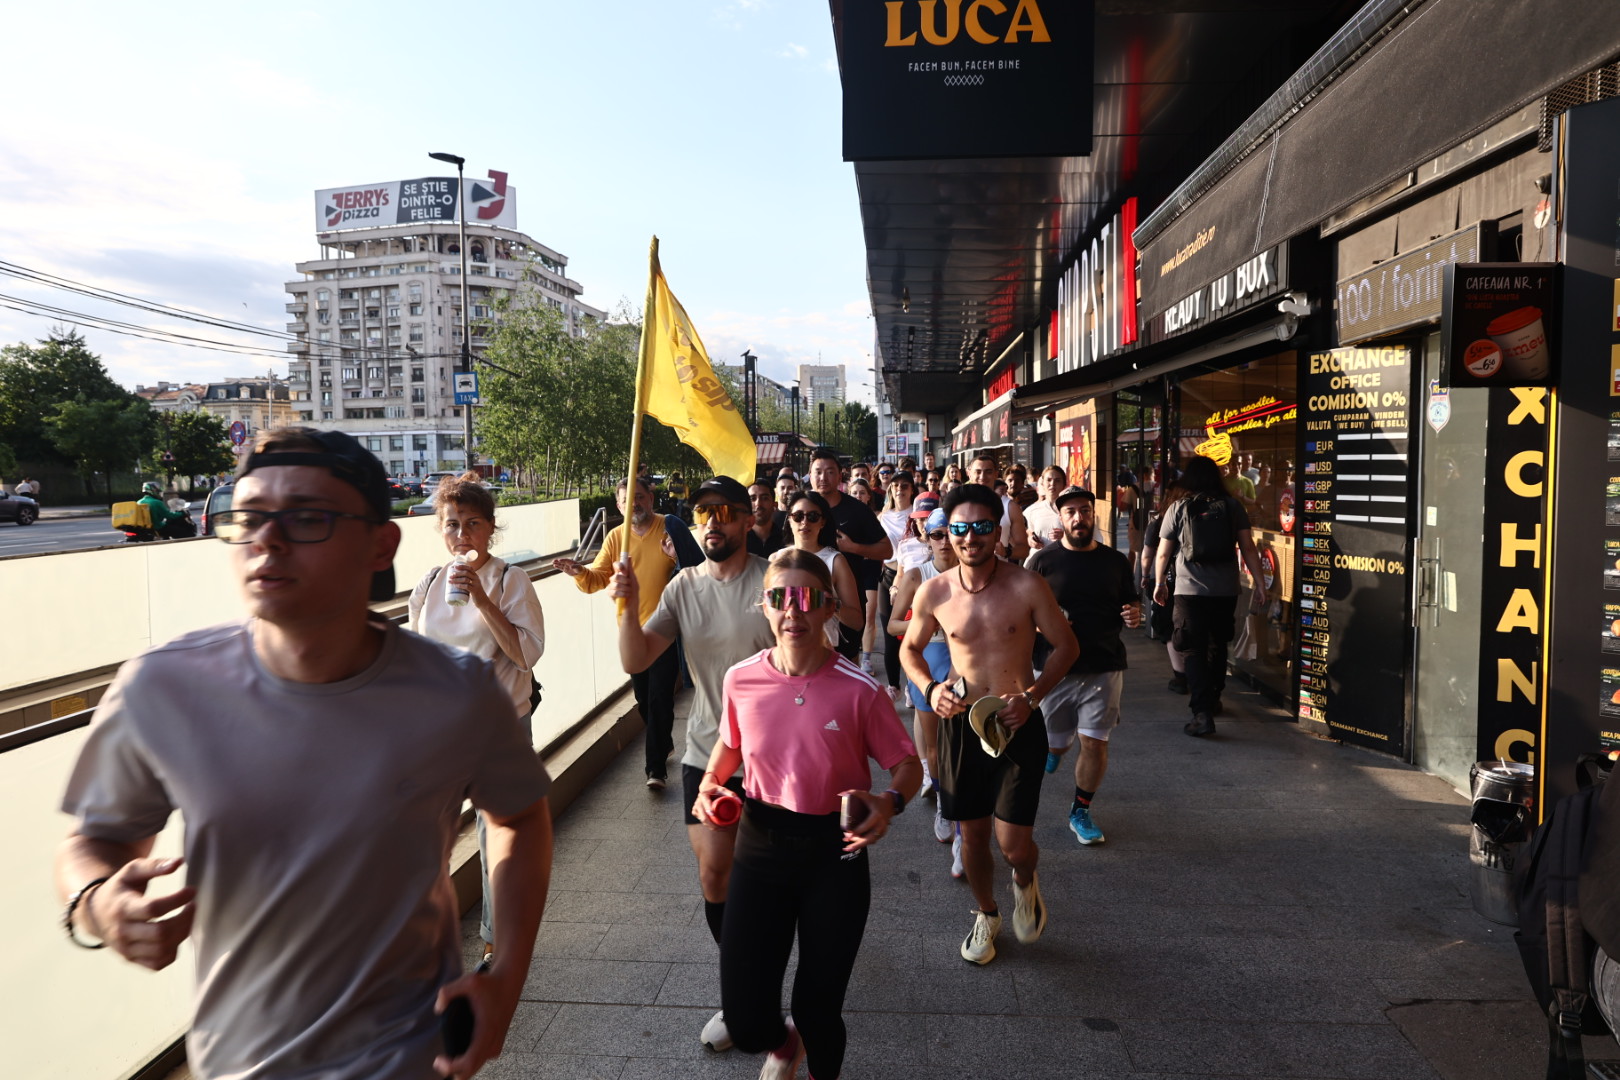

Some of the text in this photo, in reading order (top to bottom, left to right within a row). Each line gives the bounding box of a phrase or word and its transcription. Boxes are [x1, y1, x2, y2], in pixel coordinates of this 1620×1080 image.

[884, 0, 1052, 47] LUCA
[908, 59, 1020, 72] FACEM BUN, FACEM BINE
[404, 182, 418, 195] SE
[401, 194, 453, 208] DINTR-O
[342, 206, 380, 222] pizza
[411, 207, 442, 220] FELIE
[1465, 275, 1511, 290] CAFEAUA
[1164, 289, 1203, 335] READY
[1236, 249, 1269, 300] BOX
[1338, 277, 1373, 329] 100
[1310, 345, 1406, 375] EXCHANGE
[1330, 372, 1381, 390] OFFICE
[1308, 390, 1407, 412] COMISION 0%
[1206, 395, 1276, 425] all for noodles
[1333, 410, 1405, 422] CUMPARAM VINDEM
[1226, 418, 1263, 434] noodles
[1265, 414, 1281, 429] for
[1306, 420, 1332, 431] VALUTA
[1316, 440, 1334, 451] EUR
[1315, 461, 1332, 472] USD
[1315, 480, 1332, 491] GBP
[1314, 500, 1331, 510] CHF
[1314, 522, 1332, 532] DKK
[1313, 538, 1330, 549] SEK
[1313, 554, 1331, 565] NOK
[1334, 554, 1405, 575] COMISION 0%
[1313, 569, 1330, 580] CAD
[1312, 585, 1327, 596] JPY
[1312, 616, 1329, 628] AUD
[1313, 631, 1330, 643] AED
[1312, 646, 1328, 658] HUF
[1311, 661, 1328, 674] CZK
[1311, 677, 1327, 689] PLN
[1356, 727, 1388, 741] EXCHANGE
